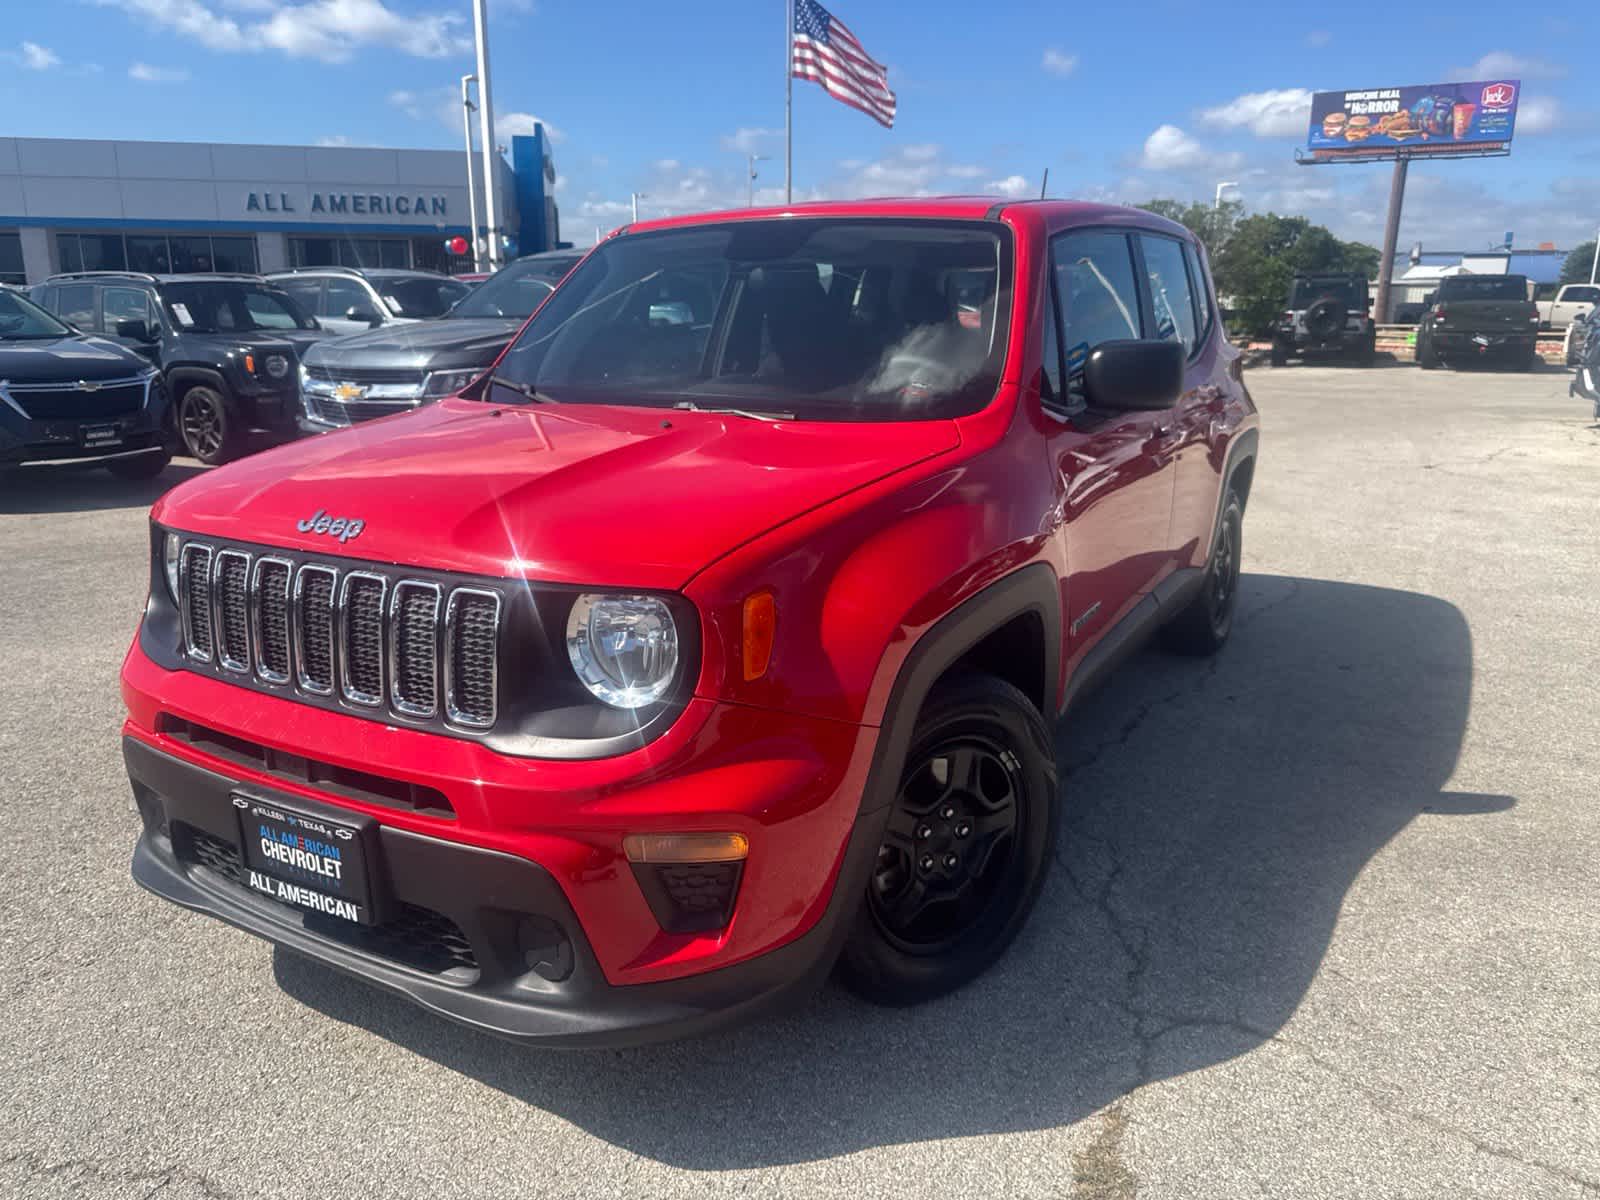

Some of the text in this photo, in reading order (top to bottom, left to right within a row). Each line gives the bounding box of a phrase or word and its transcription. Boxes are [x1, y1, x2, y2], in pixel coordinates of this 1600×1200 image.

[1379, 89, 1400, 99] MEAL
[247, 193, 447, 216] ALL AMERICAN
[297, 508, 366, 544] Jeep
[260, 825, 341, 860] ALL AMERICAN
[298, 818, 326, 834] TEXAS
[261, 838, 342, 880] CHEVROLET
[250, 871, 275, 895] ALL
[278, 882, 359, 922] AMERICAN
